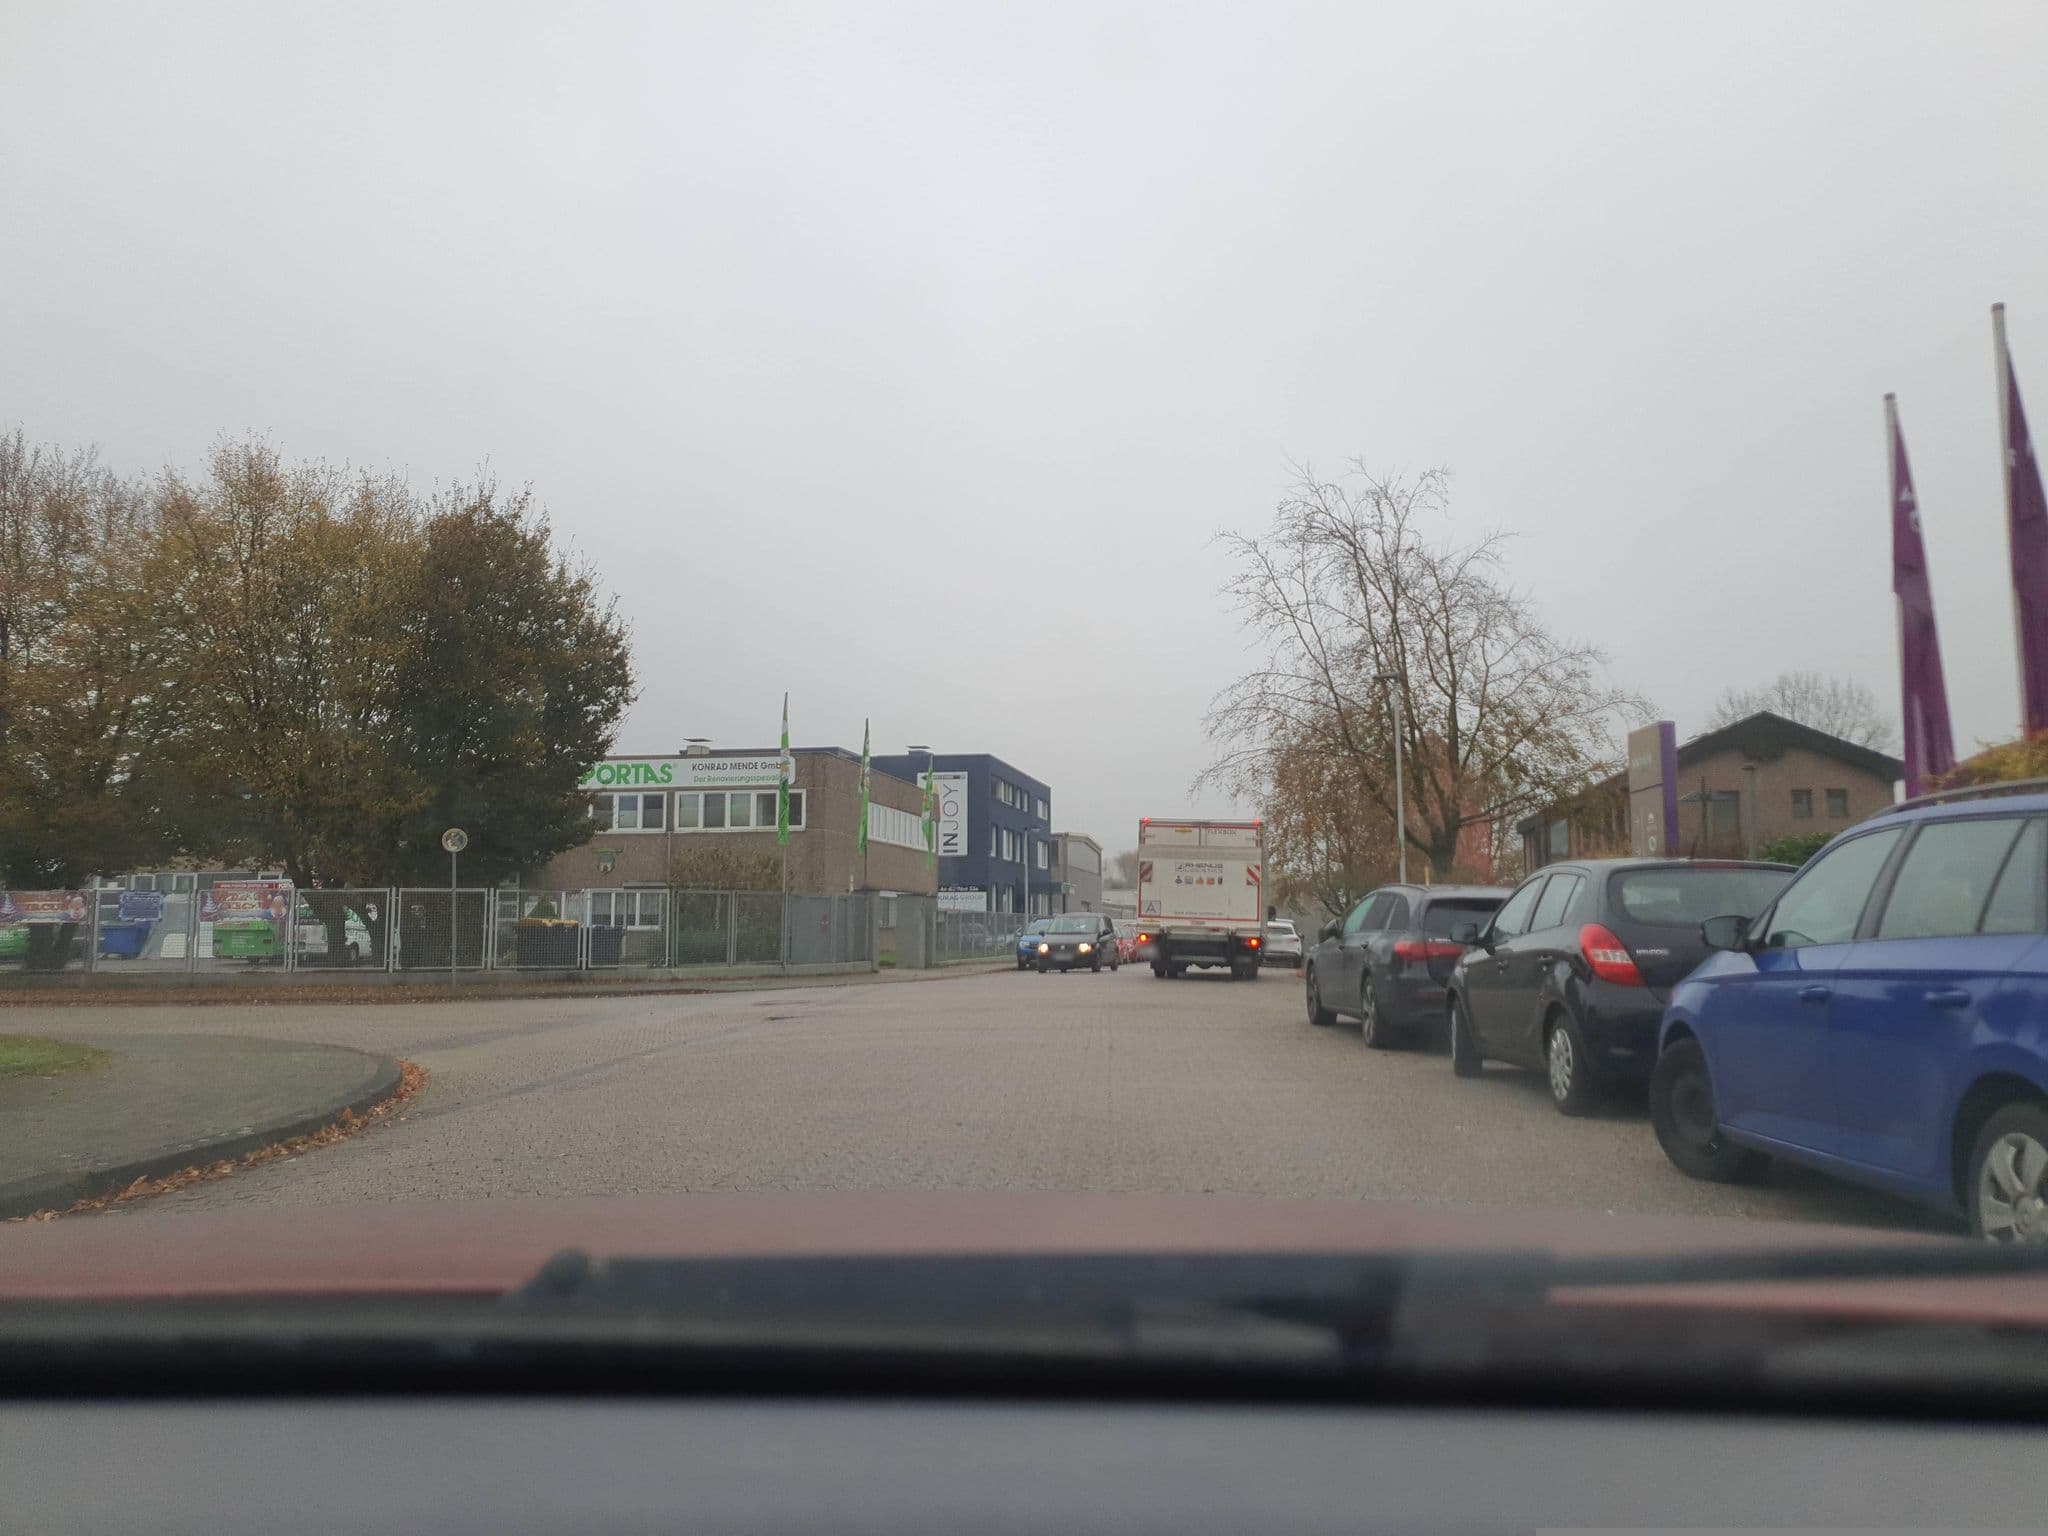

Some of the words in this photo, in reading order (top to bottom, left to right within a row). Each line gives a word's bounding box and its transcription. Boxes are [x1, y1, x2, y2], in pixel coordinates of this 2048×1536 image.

[580, 762, 673, 785] PORTAS
[691, 762, 728, 771] KONRAD
[729, 761, 759, 770] MENDE
[760, 761, 783, 770] Gmb
[942, 783, 959, 853] INJOY
[1146, 901, 1157, 913] A
